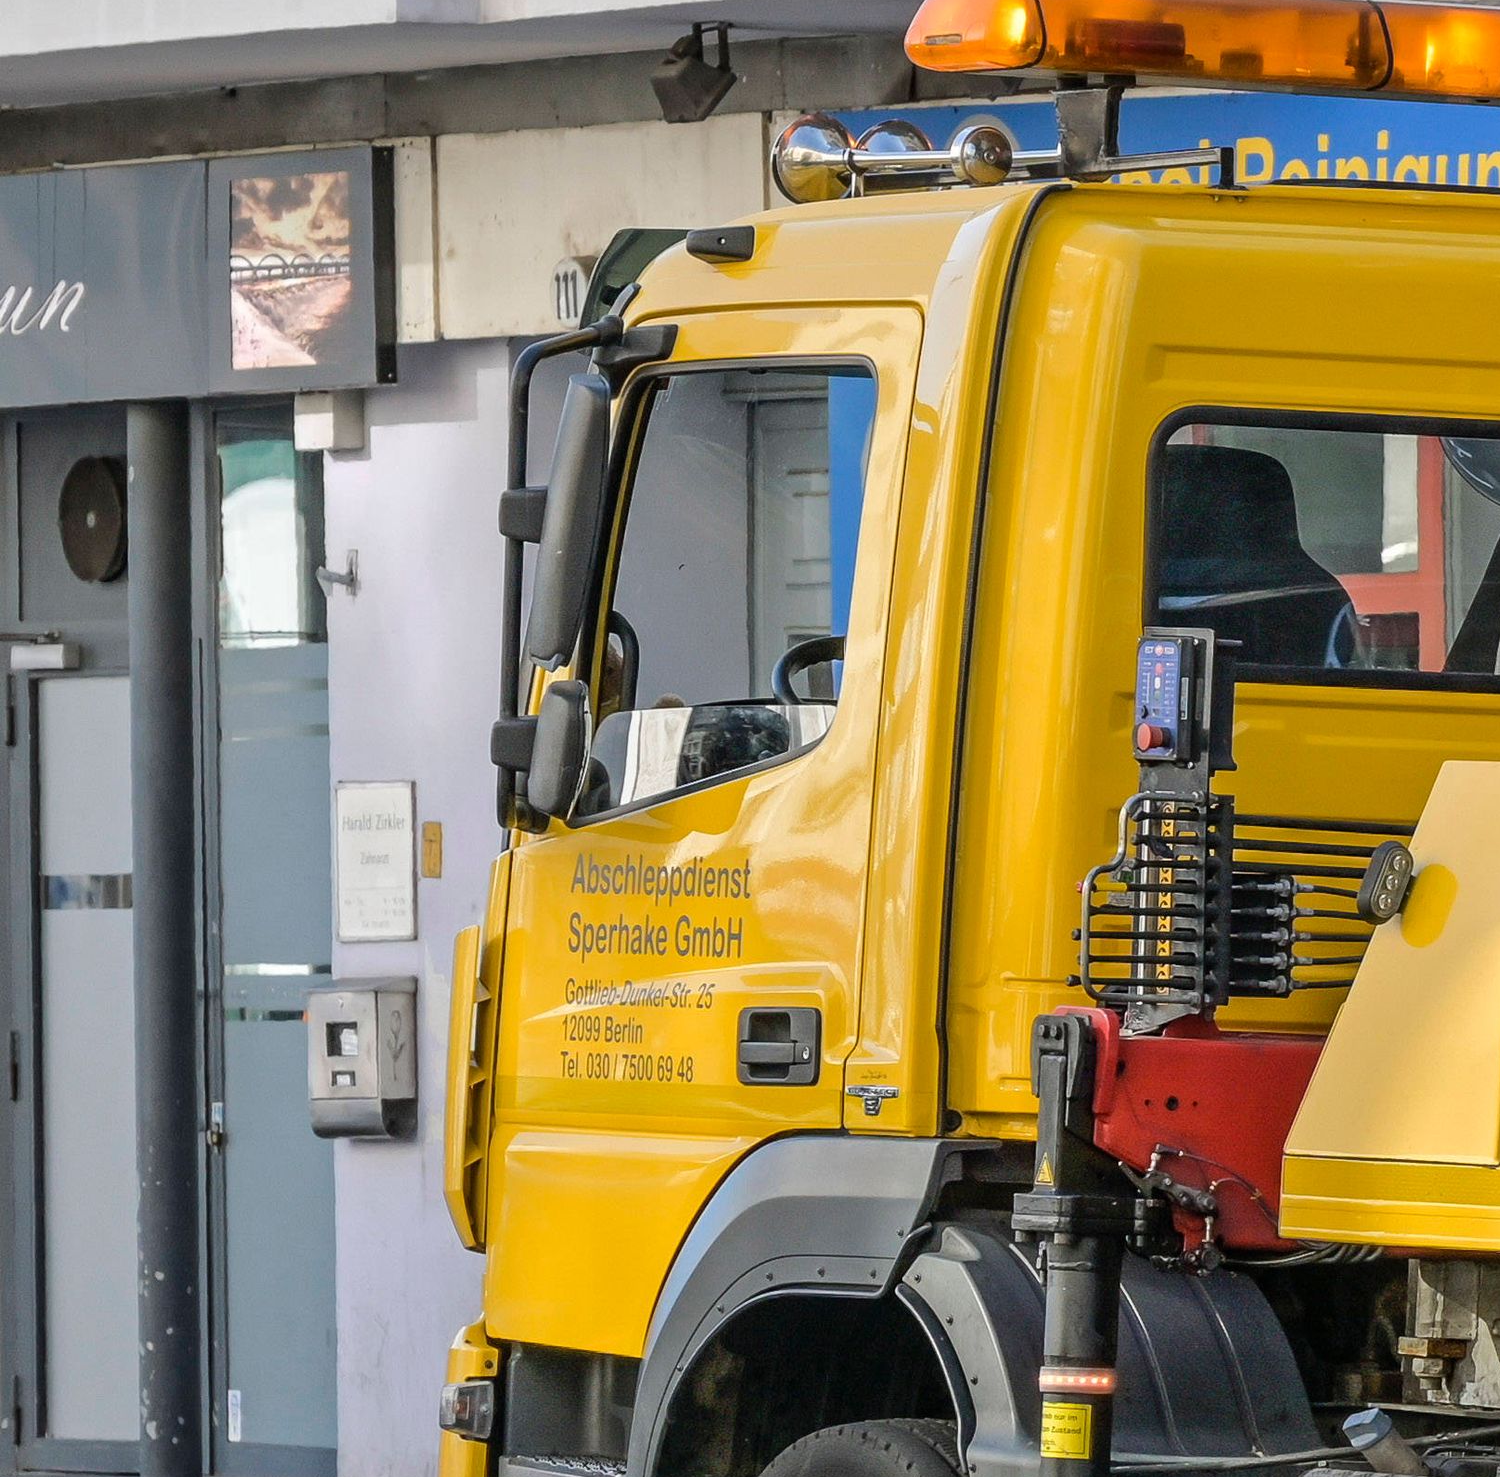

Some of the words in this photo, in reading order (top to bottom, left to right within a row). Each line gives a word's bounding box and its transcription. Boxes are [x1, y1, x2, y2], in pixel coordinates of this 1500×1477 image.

[555, 269, 578, 320] 111
[571, 853, 751, 907] Abschleppdienst
[568, 912, 668, 963] Sperhake
[675, 915, 743, 958] GmbH
[565, 978, 691, 1009] Gottlieb-Dunkel-Str.
[696, 983, 716, 1009] 25
[562, 1015, 601, 1042] 12099
[604, 1016, 643, 1044] Berlin
[560, 1051, 582, 1079] Tel.
[586, 1053, 610, 1079] 030
[622, 1054, 654, 1082] 7500
[657, 1055, 673, 1083] 69
[677, 1056, 694, 1083] 48
